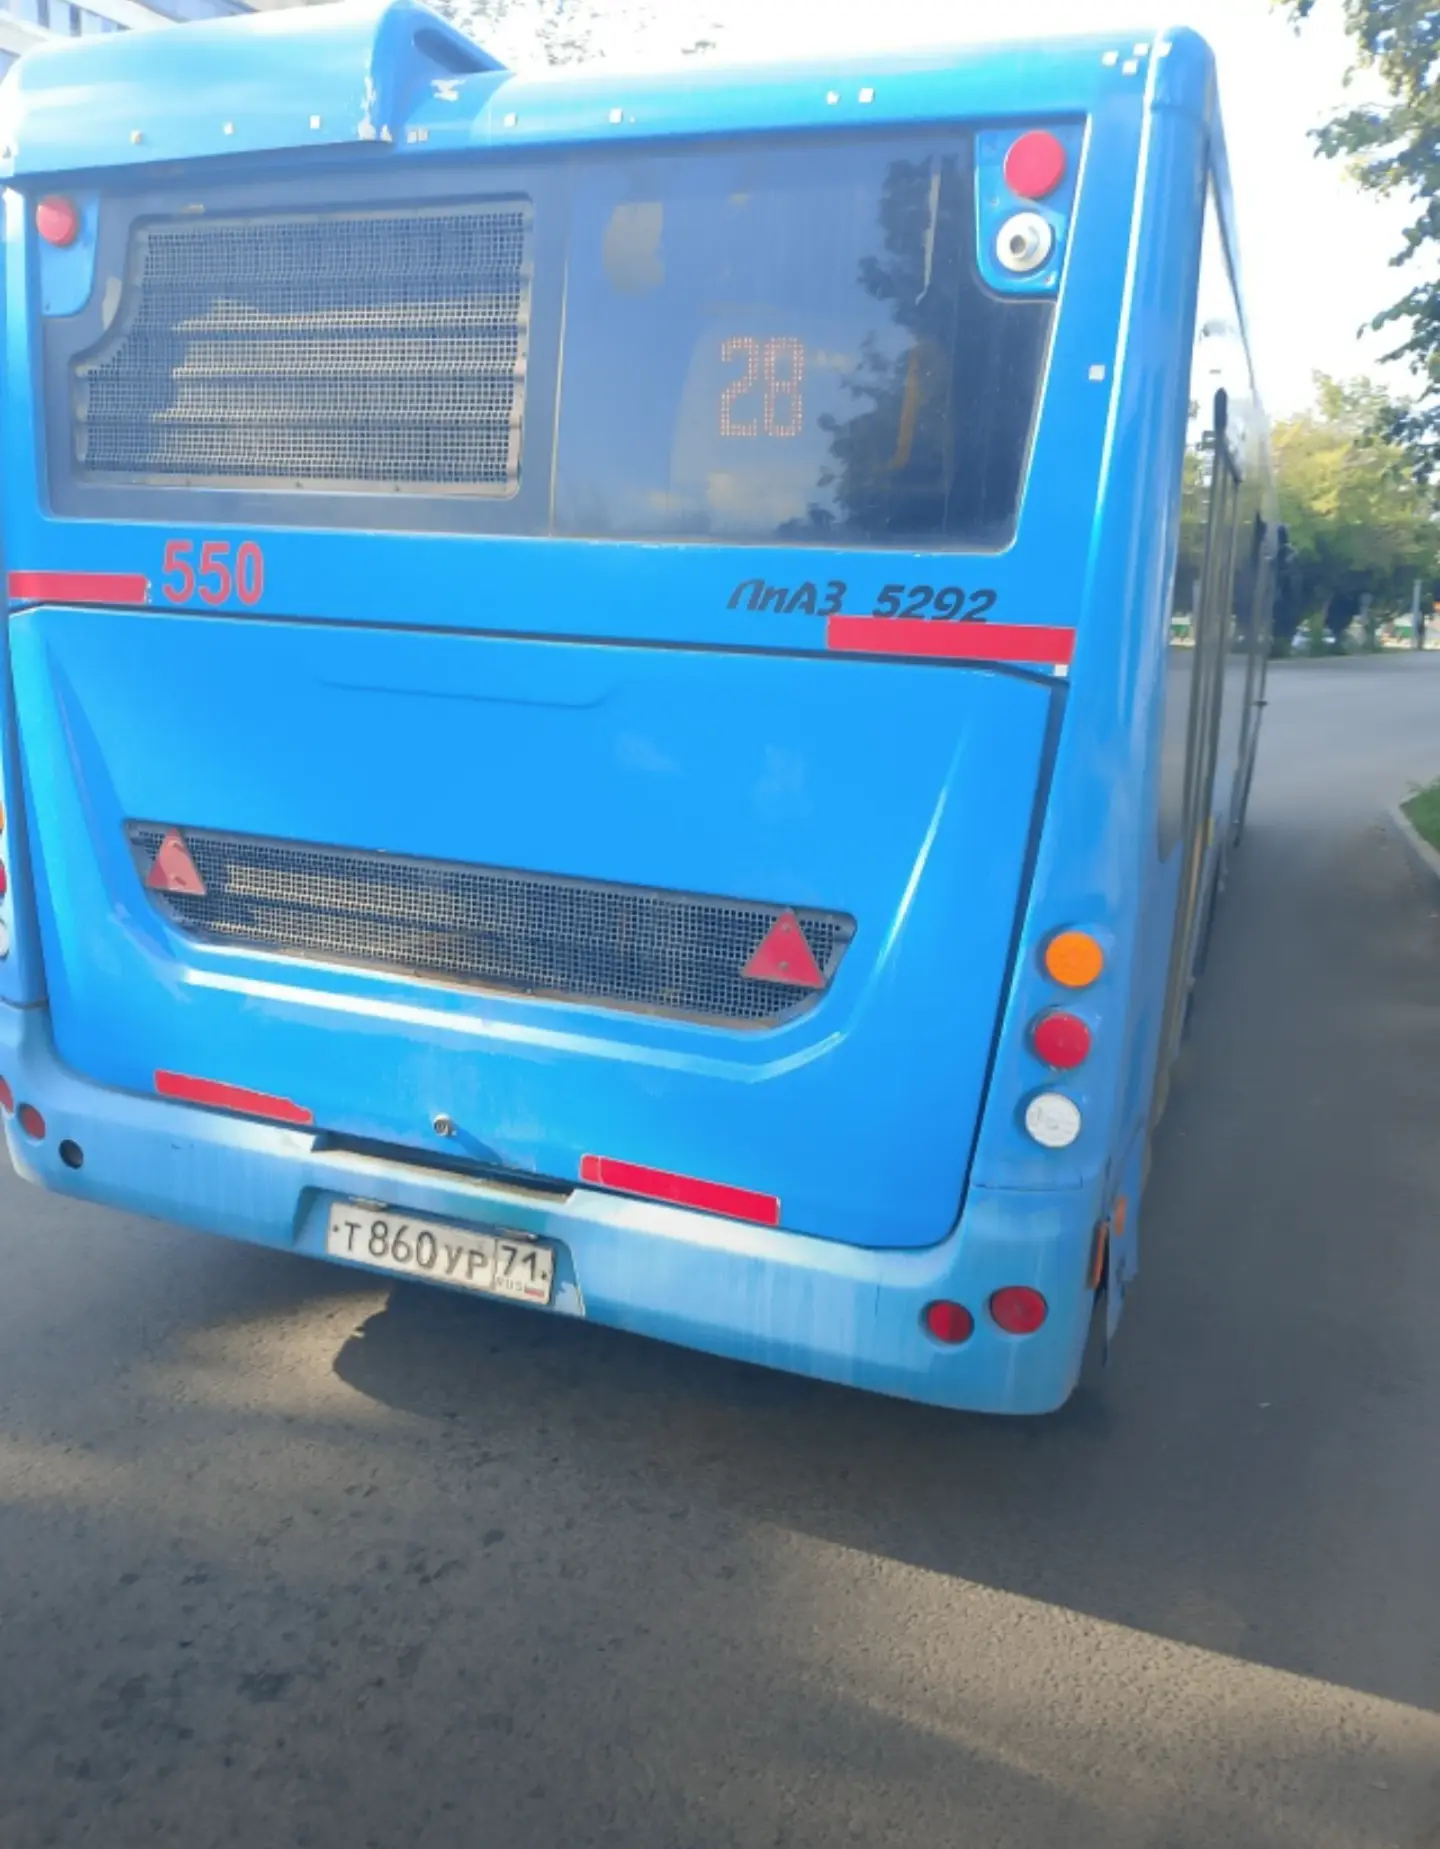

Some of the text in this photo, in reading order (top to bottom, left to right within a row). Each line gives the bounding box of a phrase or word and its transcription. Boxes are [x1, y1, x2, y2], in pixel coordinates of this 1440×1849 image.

[720, 337, 804, 437] 28
[162, 538, 264, 606] 550
[872, 583, 998, 624] 5292
[501, 1244, 537, 1282] 71
